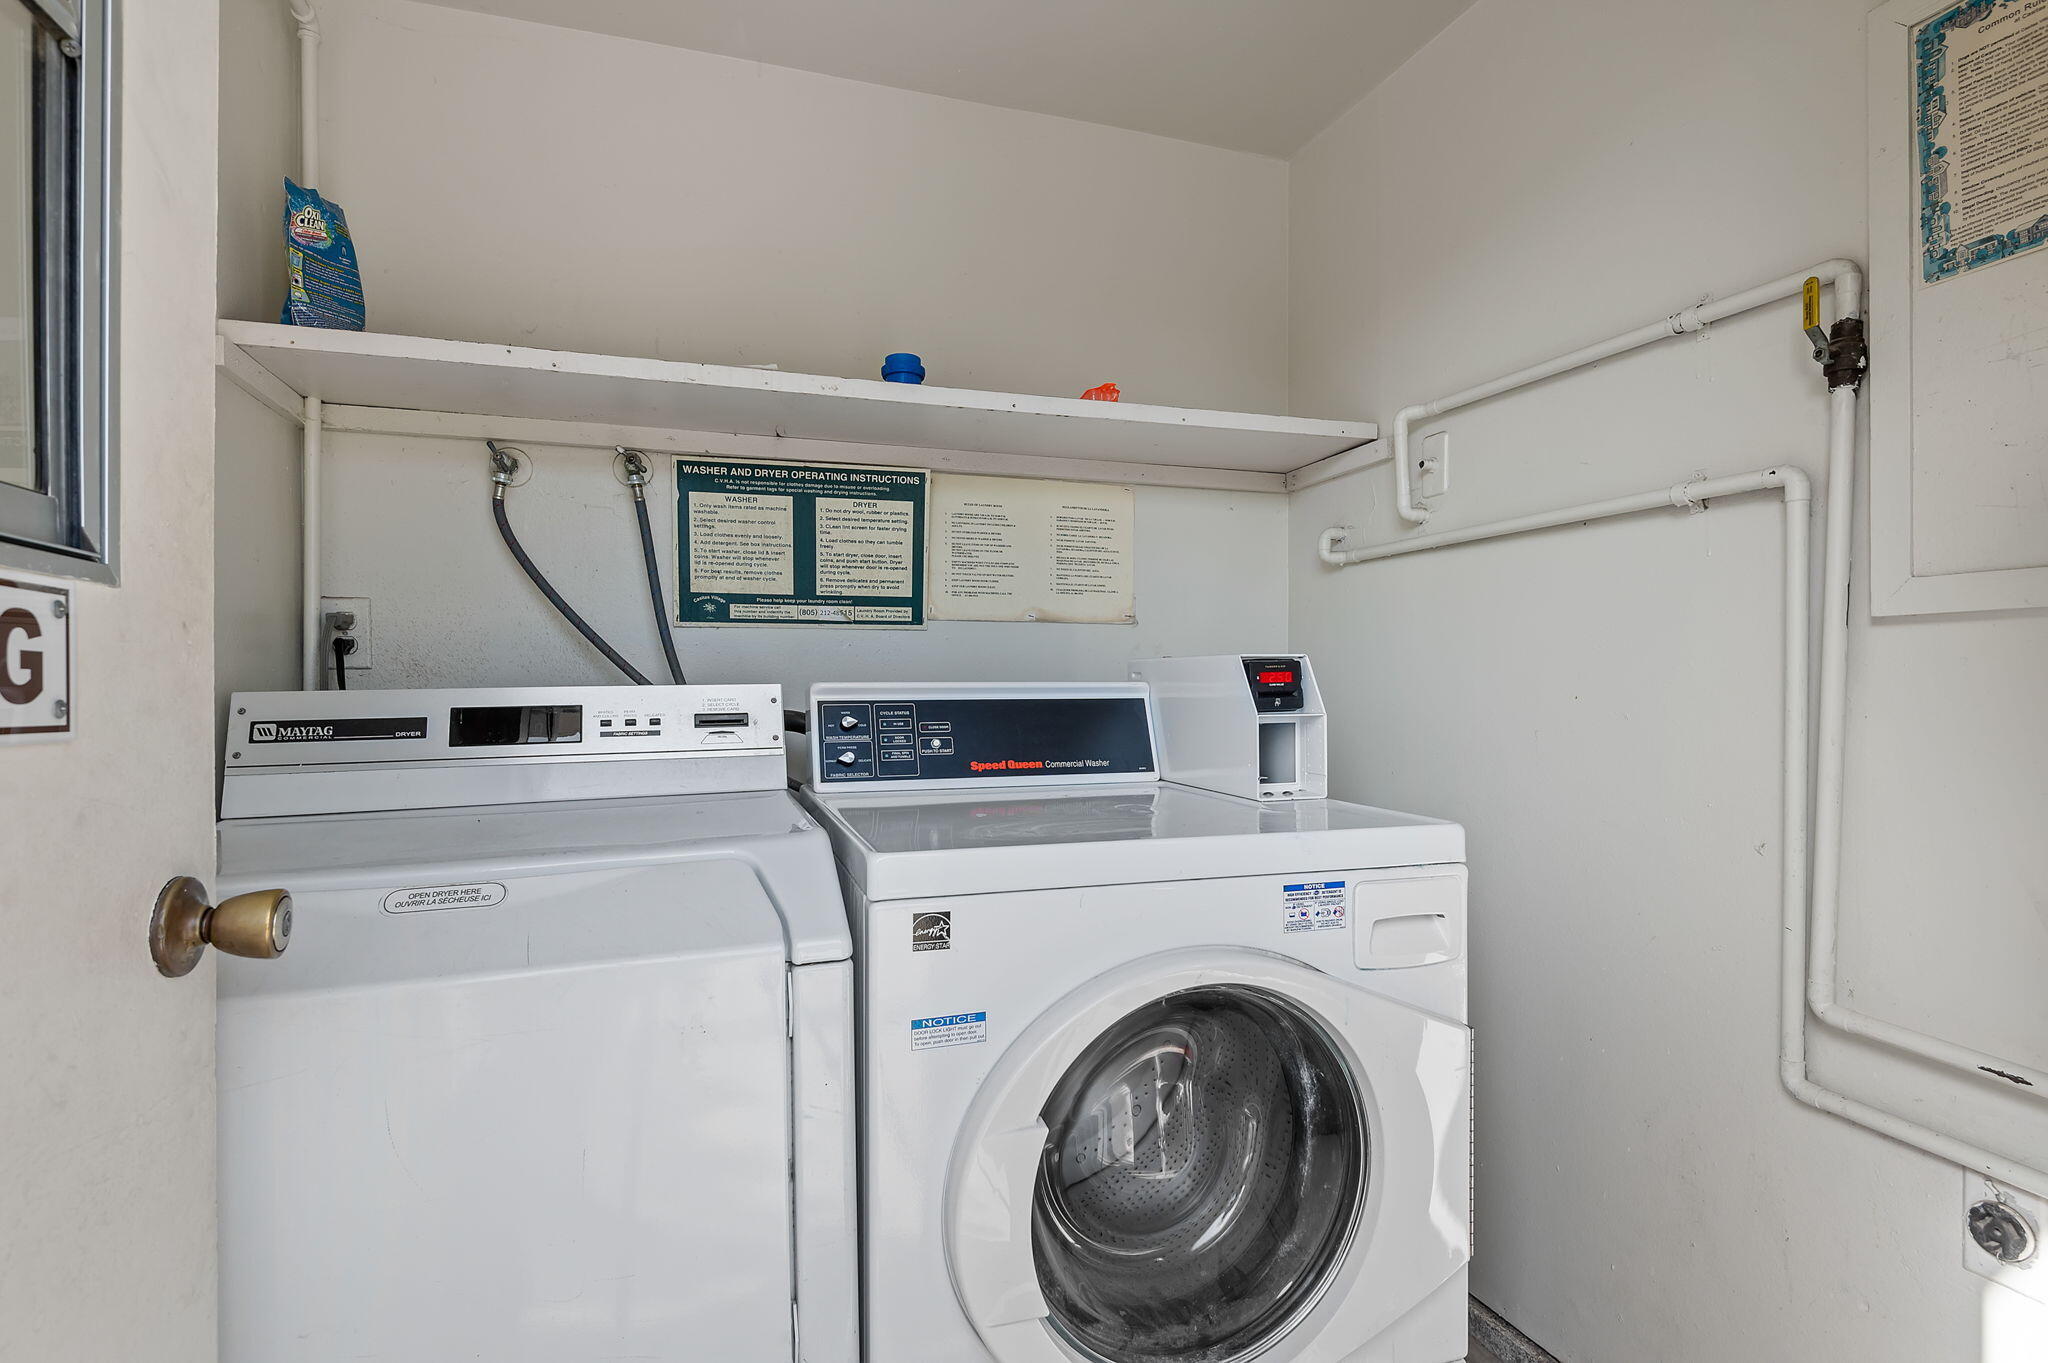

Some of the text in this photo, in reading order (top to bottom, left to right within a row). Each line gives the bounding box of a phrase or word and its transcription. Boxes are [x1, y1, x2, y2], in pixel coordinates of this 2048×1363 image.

[1978, 0, 2048, 34] Common Rul
[304, 208, 320, 220] OXI
[296, 215, 324, 230] CLEAN
[683, 465, 919, 484] WASHER AND DRYER OPERATING INSTRUCTIONS
[0, 608, 43, 704] G
[278, 726, 333, 737] MAYTAG
[970, 761, 1006, 772] Speed
[1008, 760, 1042, 769] Queen
[1045, 760, 1084, 768] Commercial
[394, 900, 425, 908] OUVRIR
[922, 1014, 976, 1027] NOTICE
